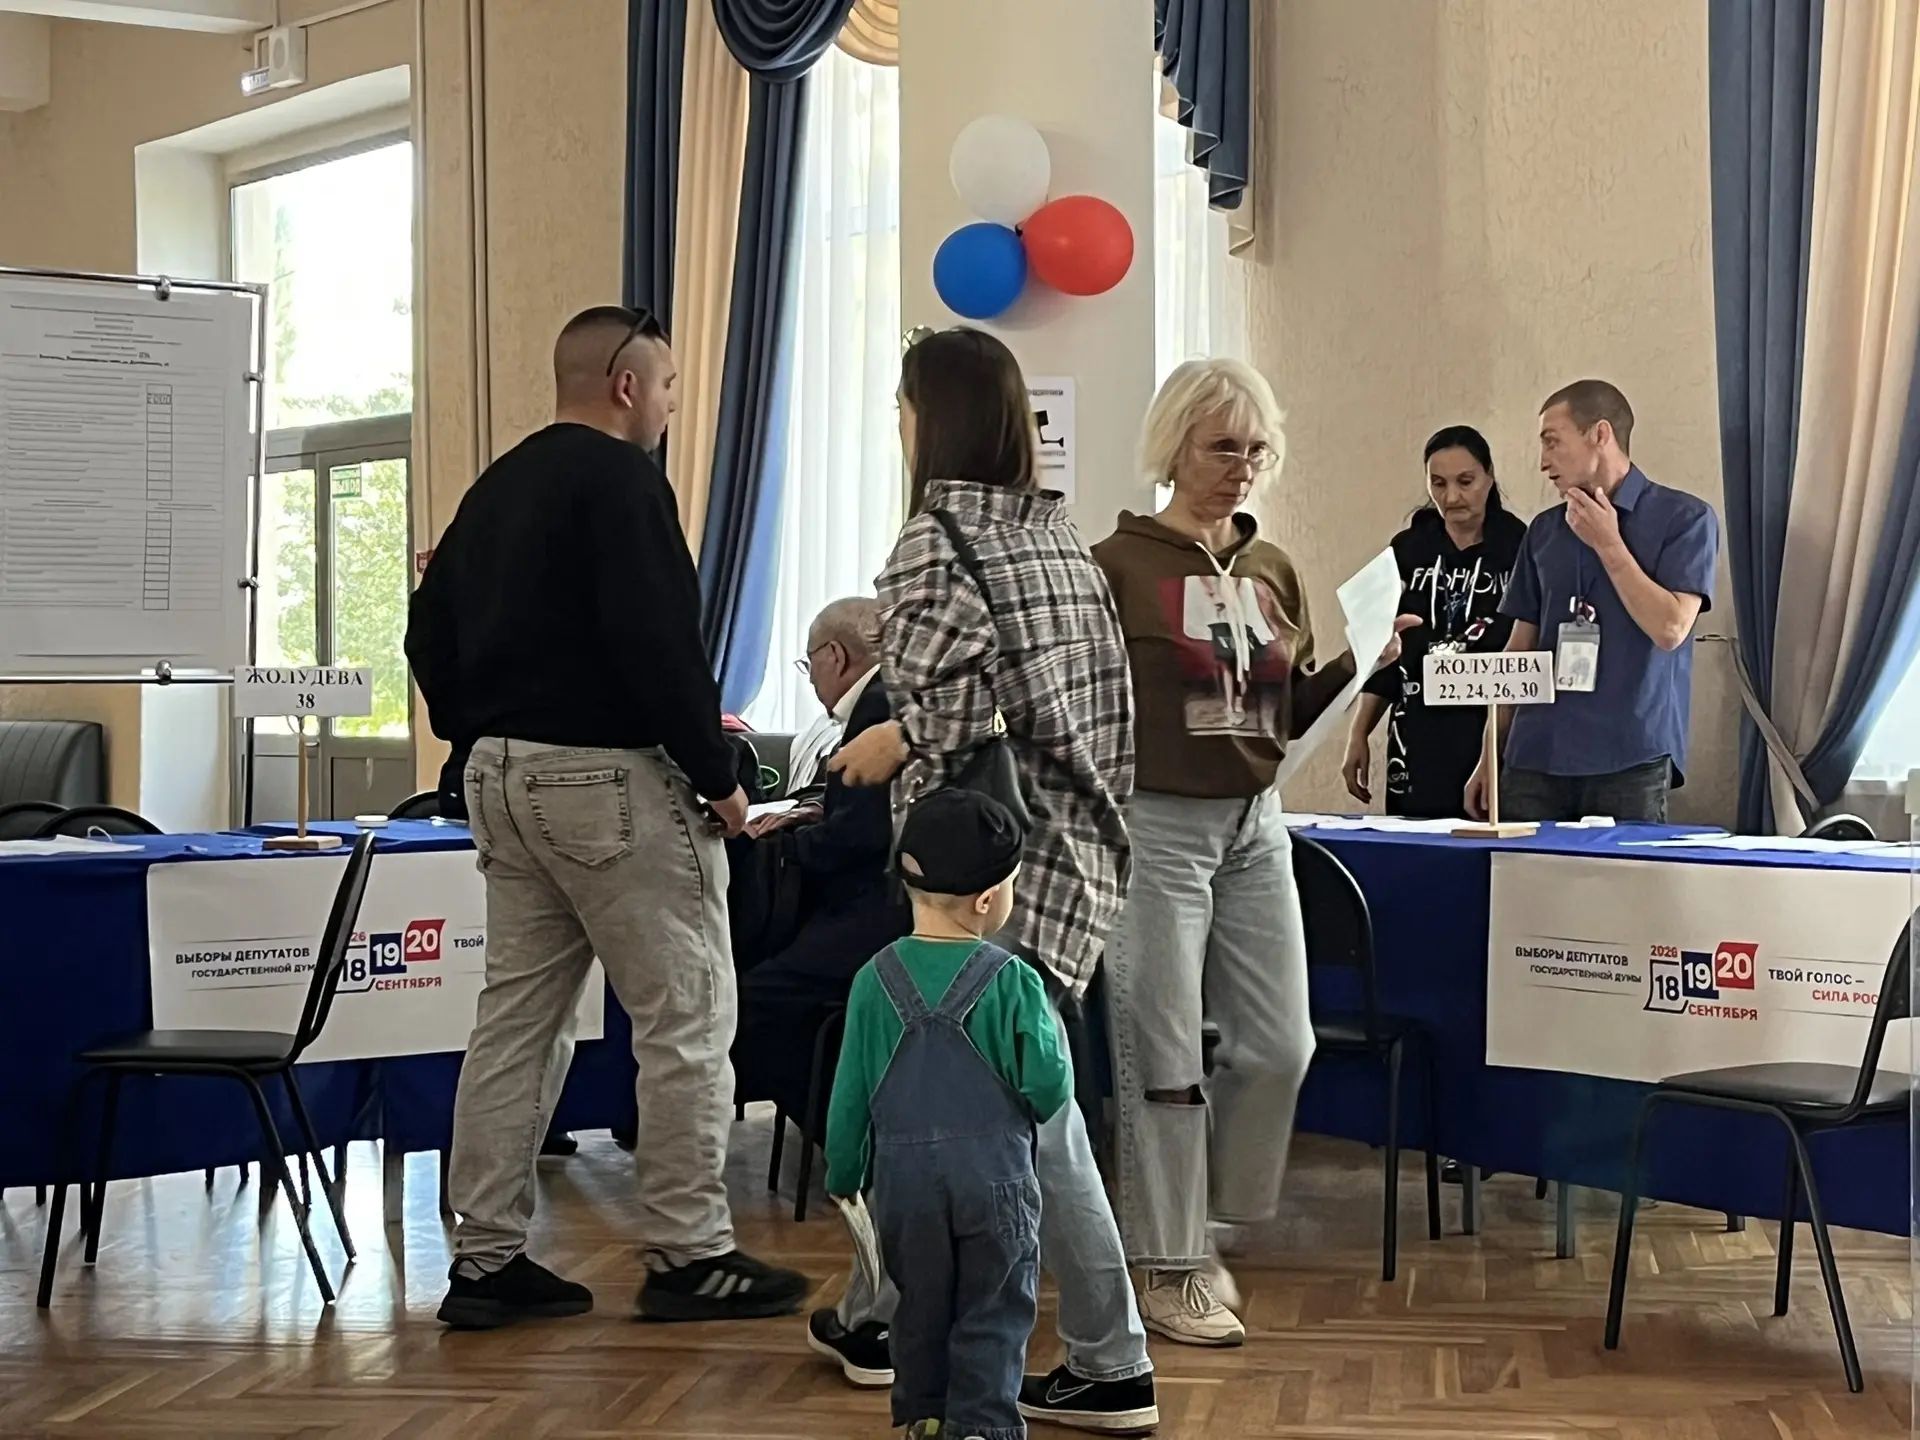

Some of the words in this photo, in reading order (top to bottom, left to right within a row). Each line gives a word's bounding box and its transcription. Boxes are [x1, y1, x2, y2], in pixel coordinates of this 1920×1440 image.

[1434, 657, 1541, 675] ЖОЛУДЕВА
[245, 668, 363, 686] ЖОЛУДЕВА
[1439, 684, 1461, 700] 22,
[1466, 684, 1488, 699] 24,
[1493, 683, 1515, 699] 26,
[1520, 682, 1538, 697] 30
[296, 693, 315, 709] 38
[350, 932, 366, 942] 26
[406, 928, 438, 953] 20
[454, 935, 484, 948] ТВОЙ
[175, 952, 231, 964] ВЫБОРЫ
[234, 947, 310, 962] ДЕПУТАТОВ
[373, 943, 400, 967] 19
[1515, 946, 1564, 960] ВЫБОРЫ
[1566, 950, 1629, 966] ДЕПУТАТОВ
[191, 962, 292, 978] ГОСУДАРСТВЕННОЙ
[294, 963, 316, 974] ДУМ
[342, 958, 366, 982] 18
[1717, 952, 1752, 980] 20
[375, 976, 442, 991] СЕНТЯБРЯ
[1684, 962, 1711, 990] 19
[1768, 968, 1803, 982] ТВОЙ
[1806, 972, 1852, 985] ГОЛОС
[1655, 975, 1680, 1001] 18
[1812, 989, 1849, 1002] СИЛА
[1852, 993, 1878, 1004] РОС
[1688, 1004, 1758, 1020] СЕНТЯБРЯ
